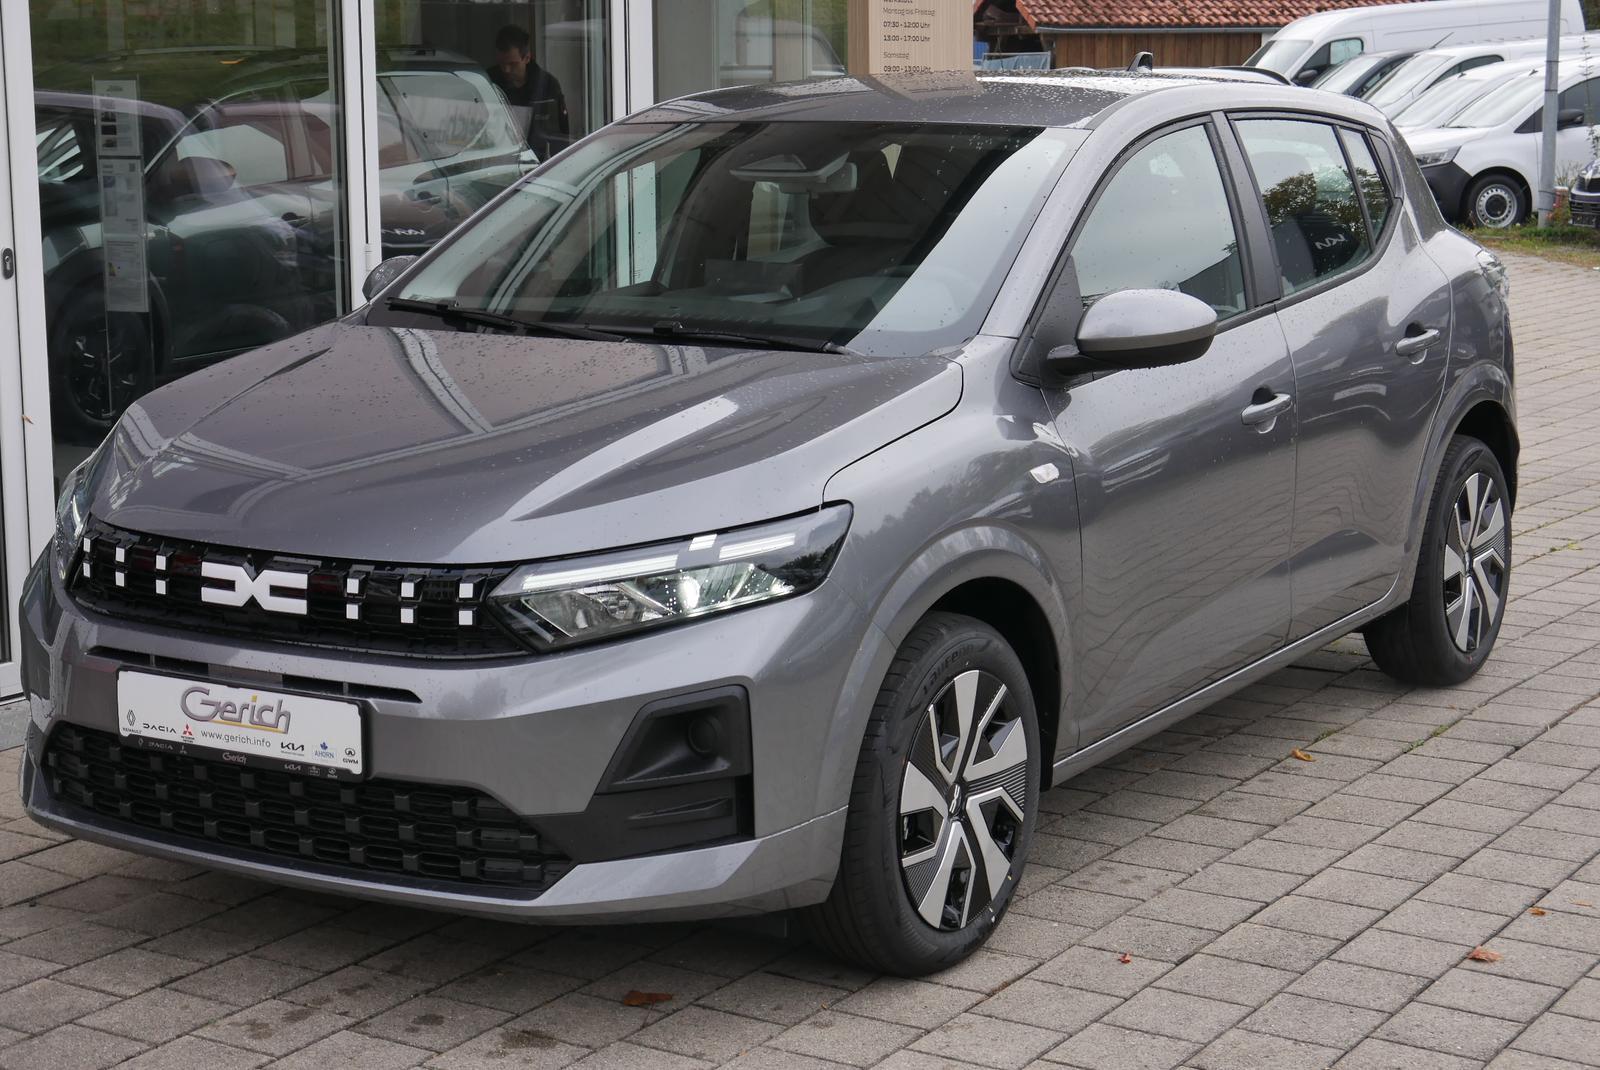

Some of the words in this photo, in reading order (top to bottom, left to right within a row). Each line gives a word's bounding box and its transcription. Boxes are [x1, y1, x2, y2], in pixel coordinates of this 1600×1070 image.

[181, 686, 291, 735] Gerich
[142, 722, 177, 734] DACIA
[201, 730, 271, 748] www.gerich.info
[222, 751, 248, 765] Gerich
[314, 750, 335, 759] AHORN
